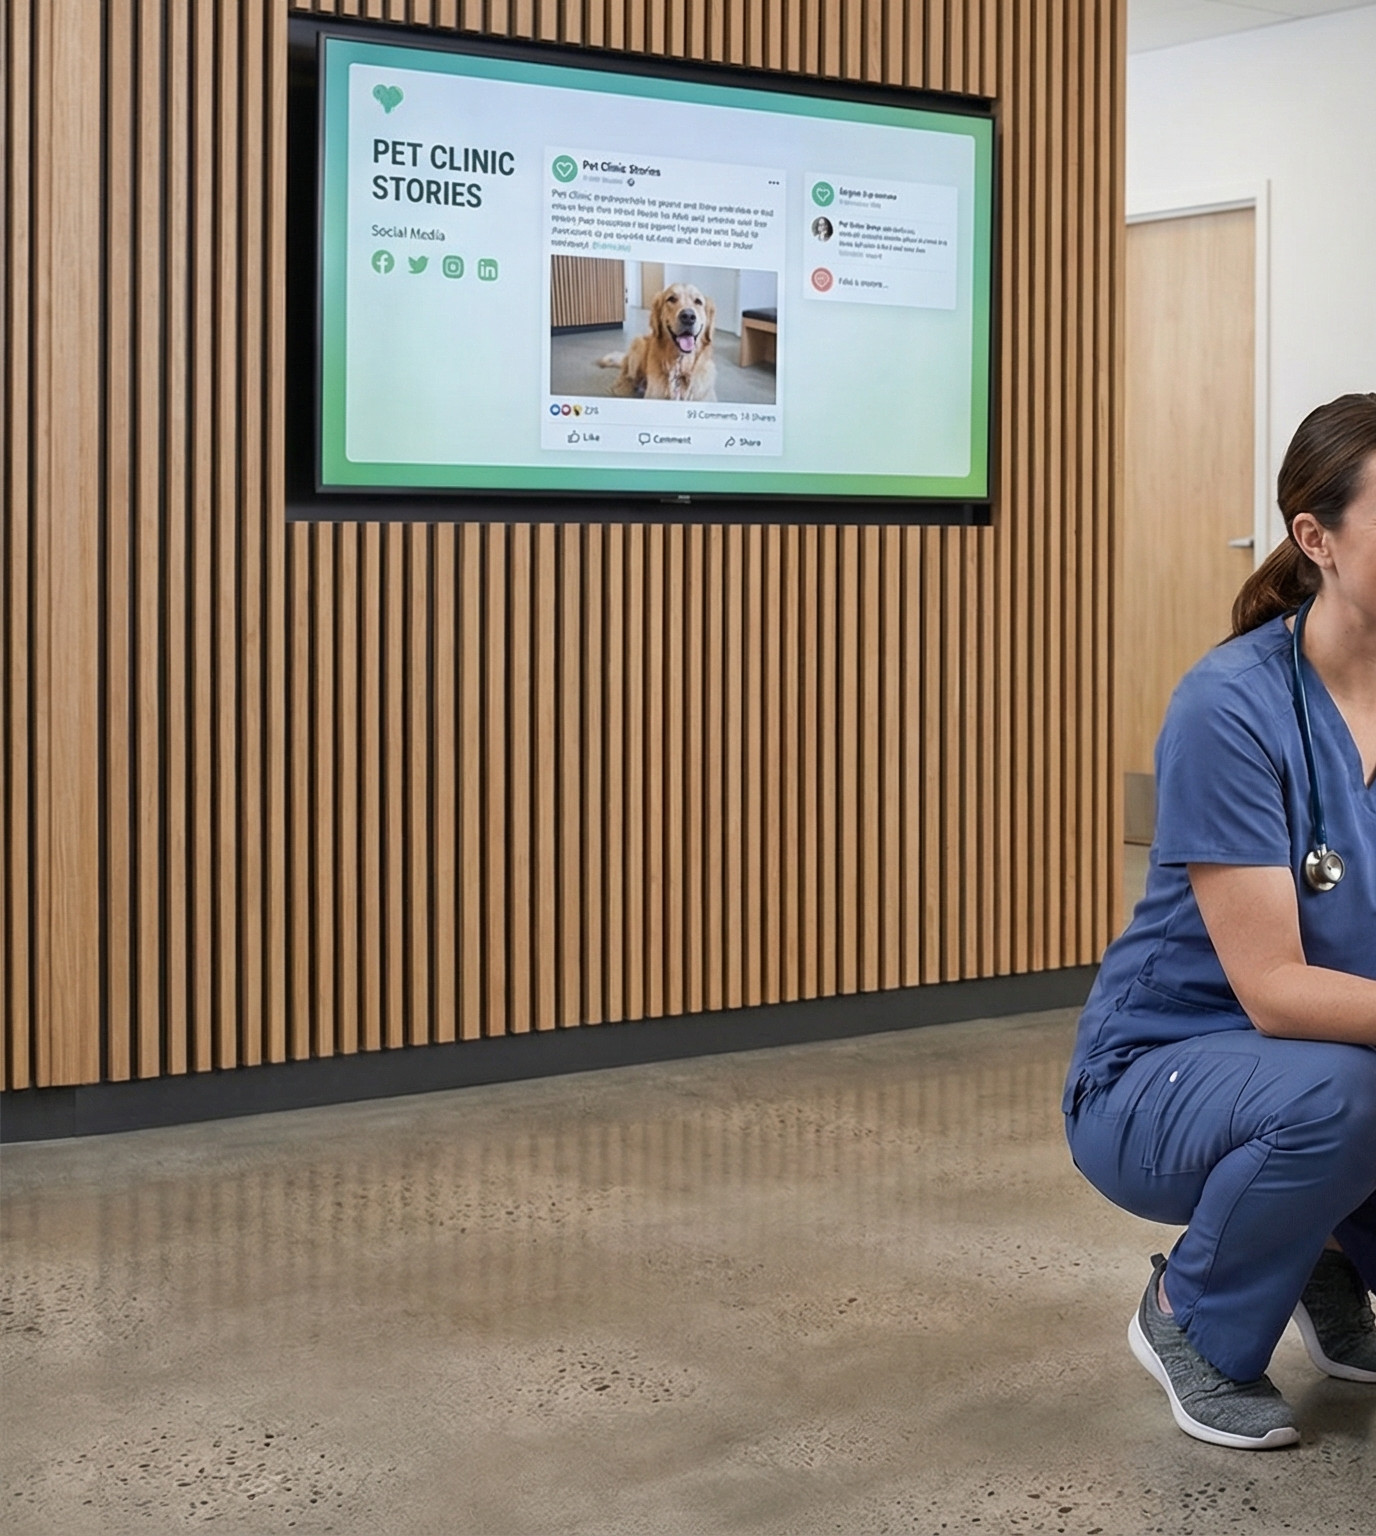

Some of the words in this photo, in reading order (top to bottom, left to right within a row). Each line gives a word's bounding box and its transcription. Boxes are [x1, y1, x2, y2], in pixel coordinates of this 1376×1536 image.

[373, 138, 423, 167] PET
[430, 144, 515, 176] CLINIC
[372, 174, 482, 208] STORIES
[371, 224, 407, 238] Social
[410, 226, 446, 242] Media
[583, 432, 600, 442] Like
[653, 434, 691, 444] Comment
[739, 438, 762, 447] Share
